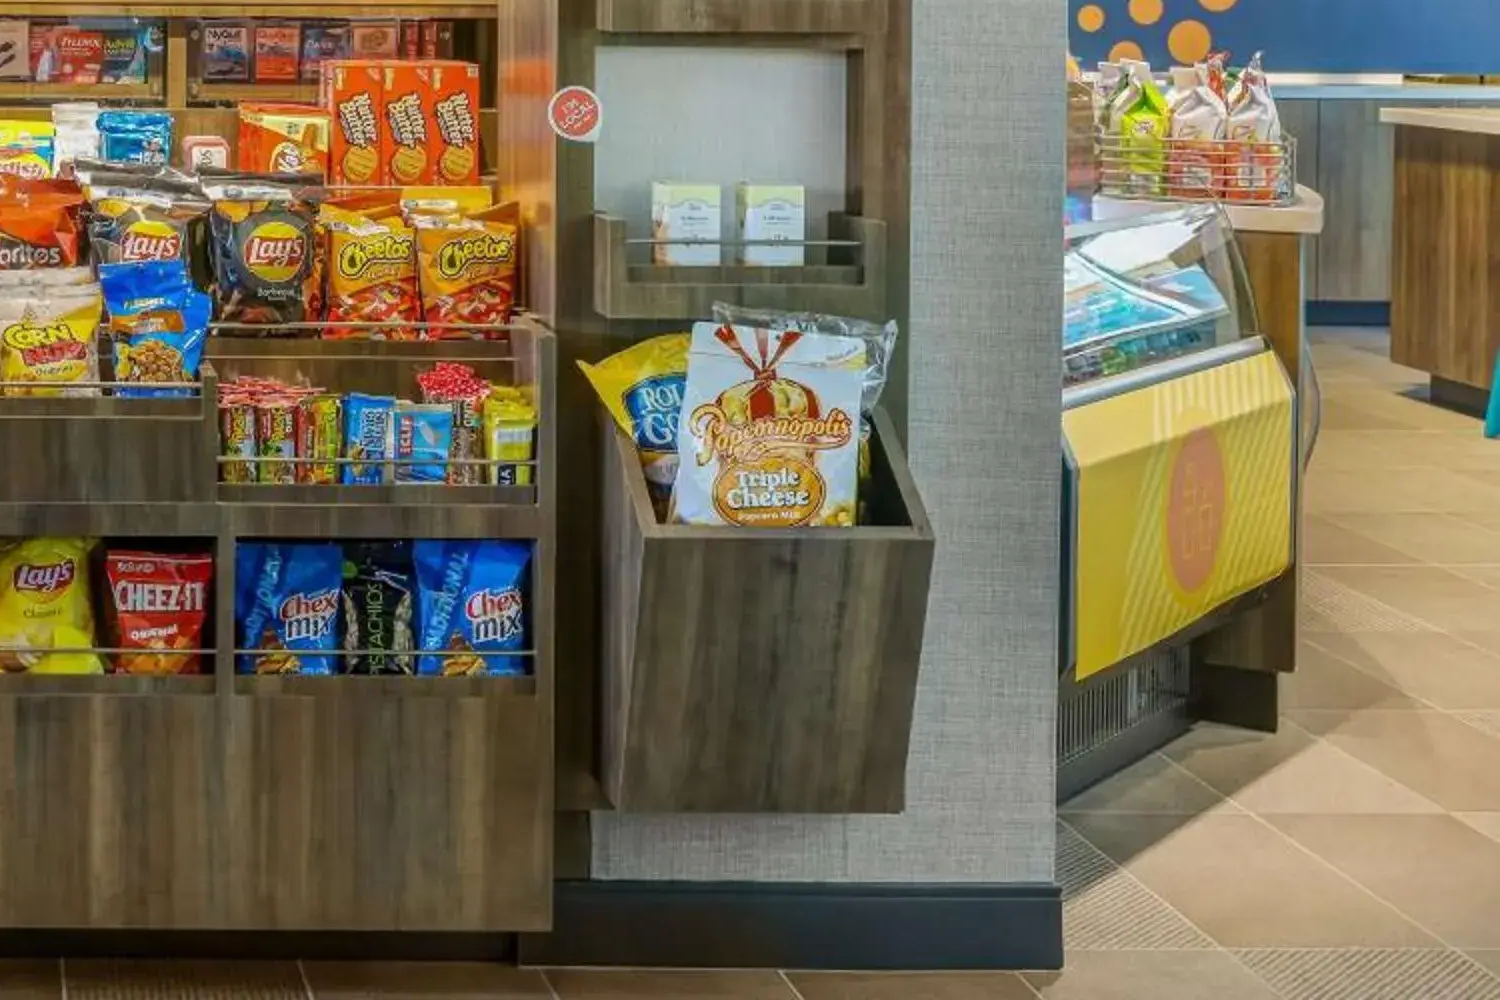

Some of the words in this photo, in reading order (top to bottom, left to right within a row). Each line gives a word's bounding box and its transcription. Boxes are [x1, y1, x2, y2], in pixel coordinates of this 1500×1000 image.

[123, 231, 182, 260] Lay's
[251, 236, 305, 267] Lay's
[341, 236, 412, 276] Cheetos
[440, 236, 511, 276] Cheetos
[643, 384, 683, 412] ROL
[643, 412, 681, 445] GO
[736, 468, 801, 492] Triple
[726, 486, 809, 510] Cheese
[16, 560, 73, 593] Lay's
[281, 588, 339, 621] Chex
[465, 588, 523, 620] Chex
[285, 613, 332, 642] mix
[473, 613, 523, 642] mix
